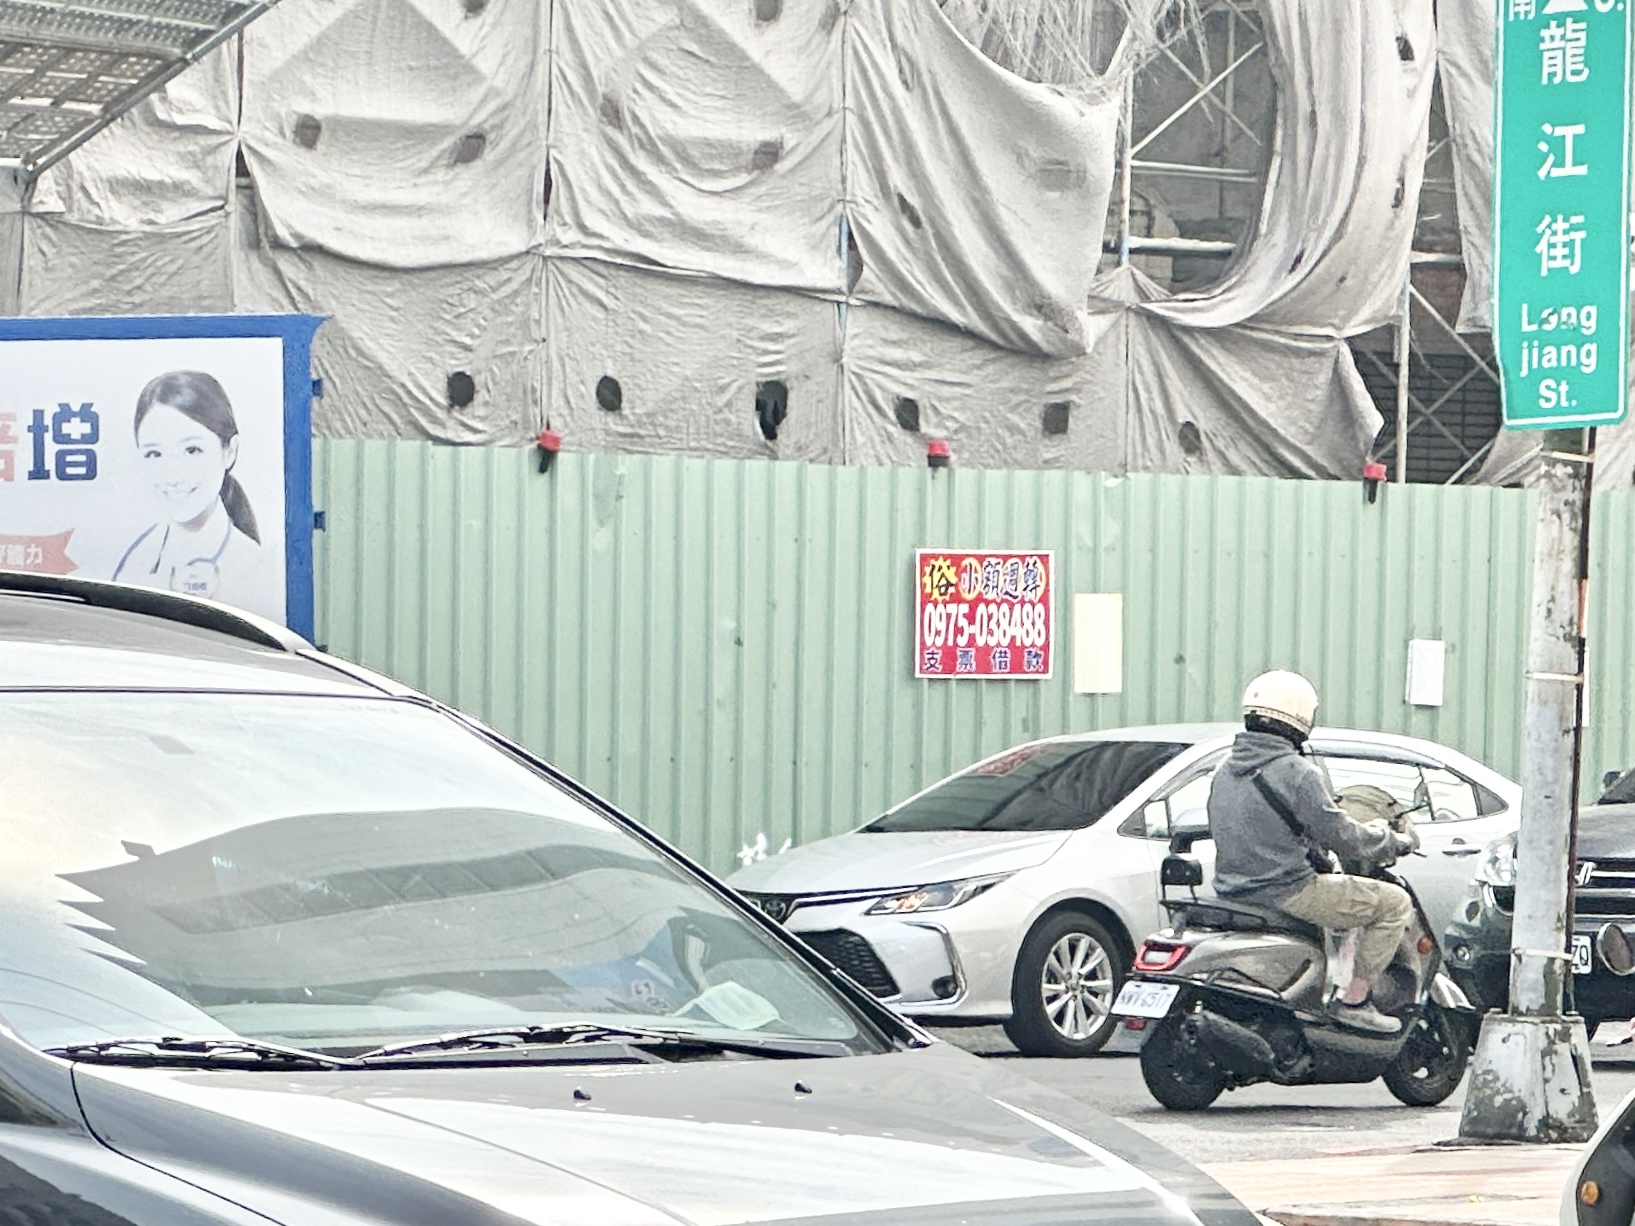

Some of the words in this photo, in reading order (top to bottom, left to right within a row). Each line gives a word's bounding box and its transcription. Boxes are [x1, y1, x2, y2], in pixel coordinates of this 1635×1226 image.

[1535, 17, 1590, 277] 龍江街
[1520, 303, 1598, 335] Long
[1519, 341, 1598, 378] jiang
[1538, 379, 1578, 409] St.
[923, 603, 1046, 647] 0975-038488
[924, 650, 1043, 671] 支票借款
